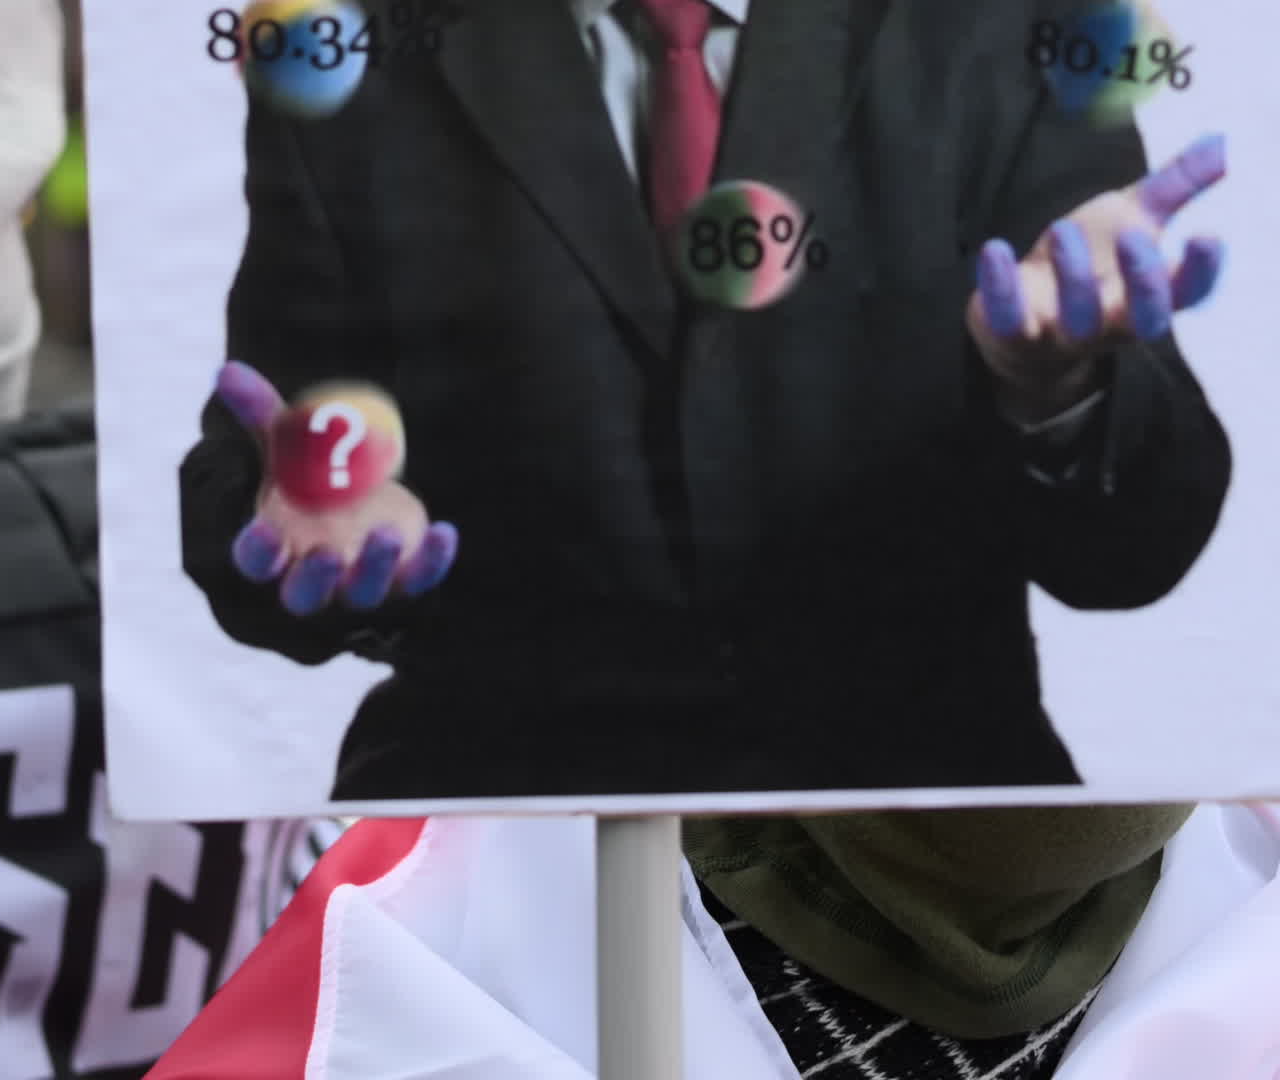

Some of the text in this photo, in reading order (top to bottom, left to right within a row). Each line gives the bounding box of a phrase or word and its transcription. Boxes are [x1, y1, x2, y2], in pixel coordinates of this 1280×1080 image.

[206, 0, 443, 70] 80.34%
[1026, 21, 1194, 90] 80.1%
[689, 209, 827, 272] 86%
[309, 400, 366, 490] ?
